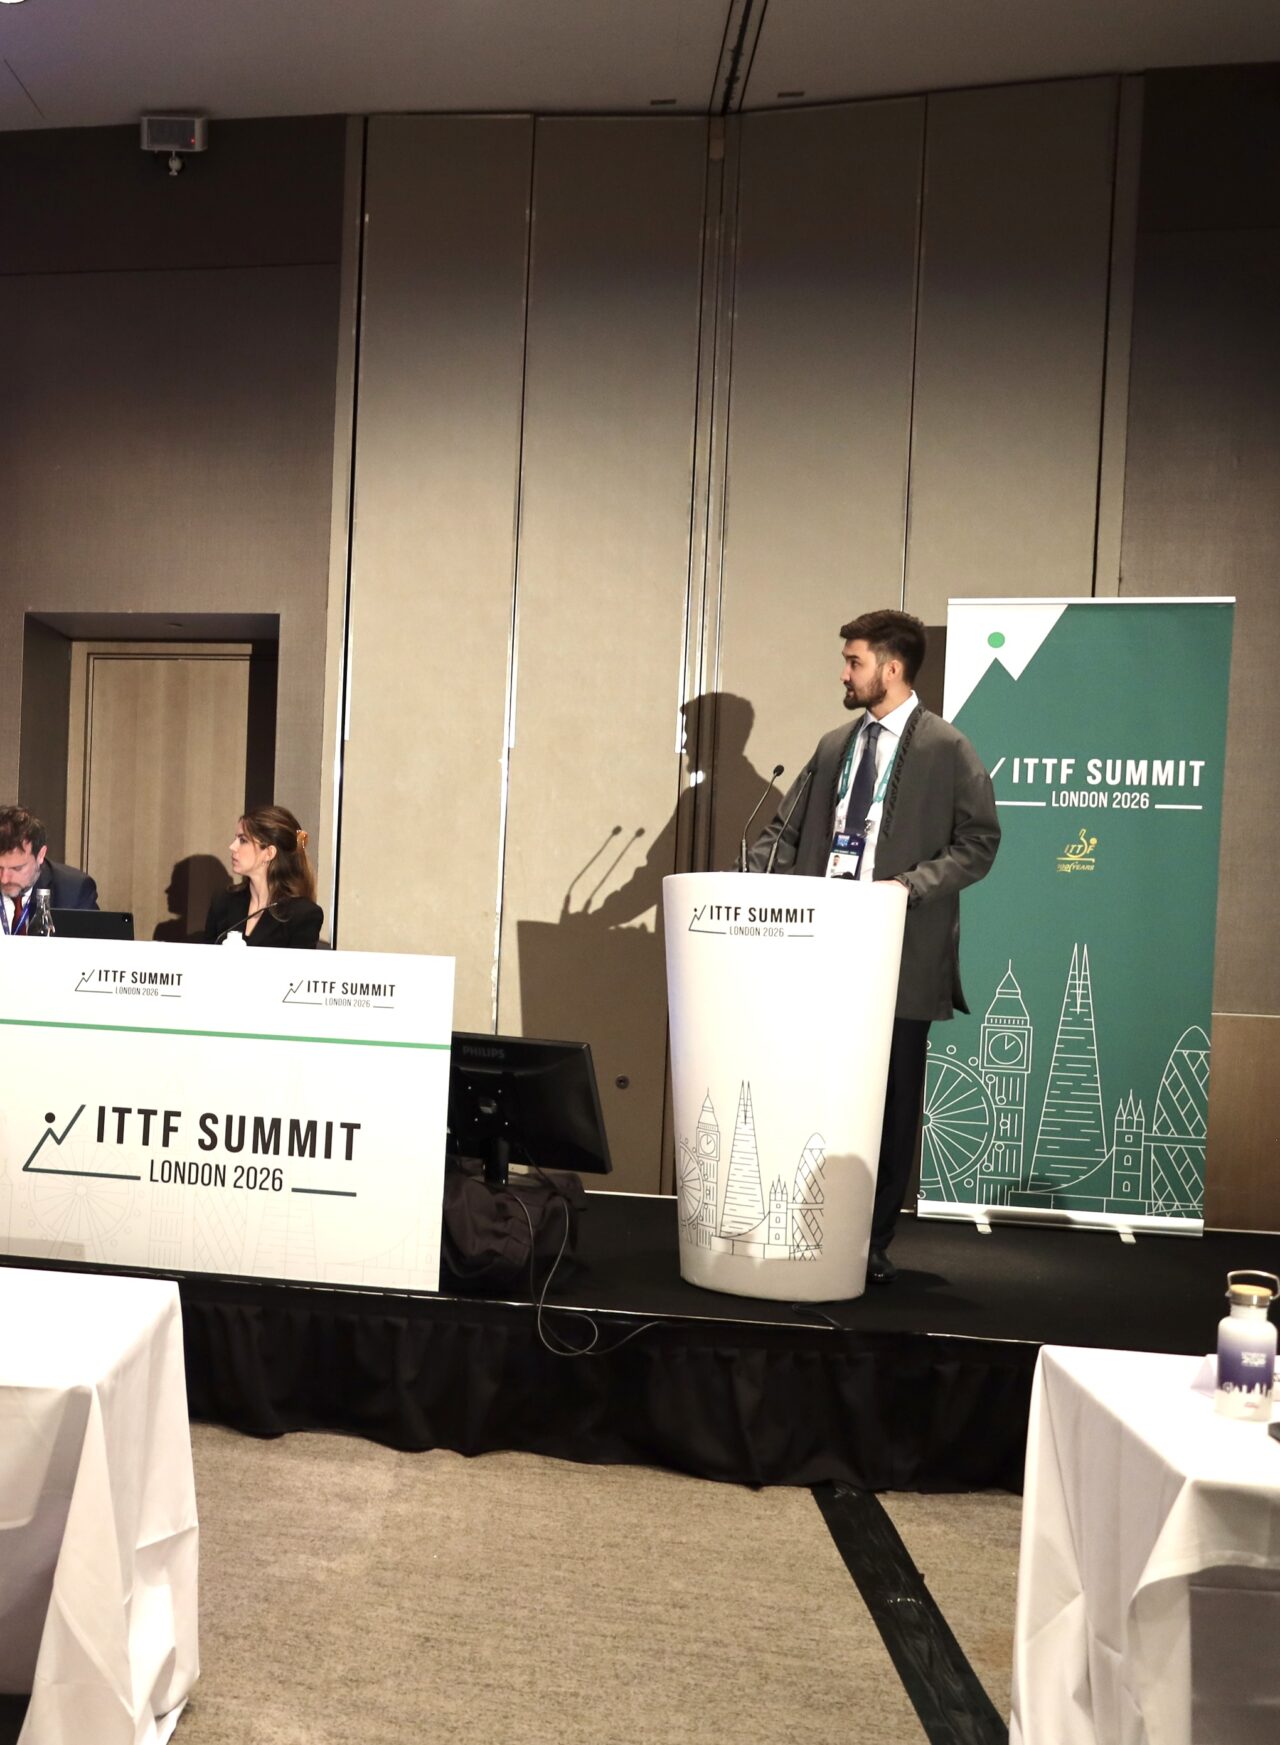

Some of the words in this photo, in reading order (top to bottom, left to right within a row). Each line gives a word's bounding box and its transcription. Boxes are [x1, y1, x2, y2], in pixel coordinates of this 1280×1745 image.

[1012, 757, 1076, 784] ITTF
[1086, 758, 1205, 787] SUMMIT
[1051, 790, 1108, 808] LONDON
[1112, 792, 1150, 809] 2026
[1064, 844, 1095, 854] ITTF
[710, 904, 742, 921] ITTF
[748, 907, 816, 923] SUMMIT
[729, 925, 761, 936] LONDON
[763, 927, 785, 937] 2026
[98, 969, 126, 984] ITTF
[131, 971, 184, 987] SUMMIT
[115, 986, 141, 996] LONDON
[142, 987, 159, 997] 2026
[307, 980, 336, 995] ITTF
[341, 981, 396, 997] SUMMIT
[324, 997, 352, 1007] LONDON
[353, 998, 371, 1009] 2026
[463, 1046, 505, 1058] PHILIPS
[96, 1106, 182, 1148] ITTF
[197, 1113, 362, 1162] SUMMIT
[149, 1159, 227, 1188] LONDON
[233, 1163, 284, 1193] 2026
